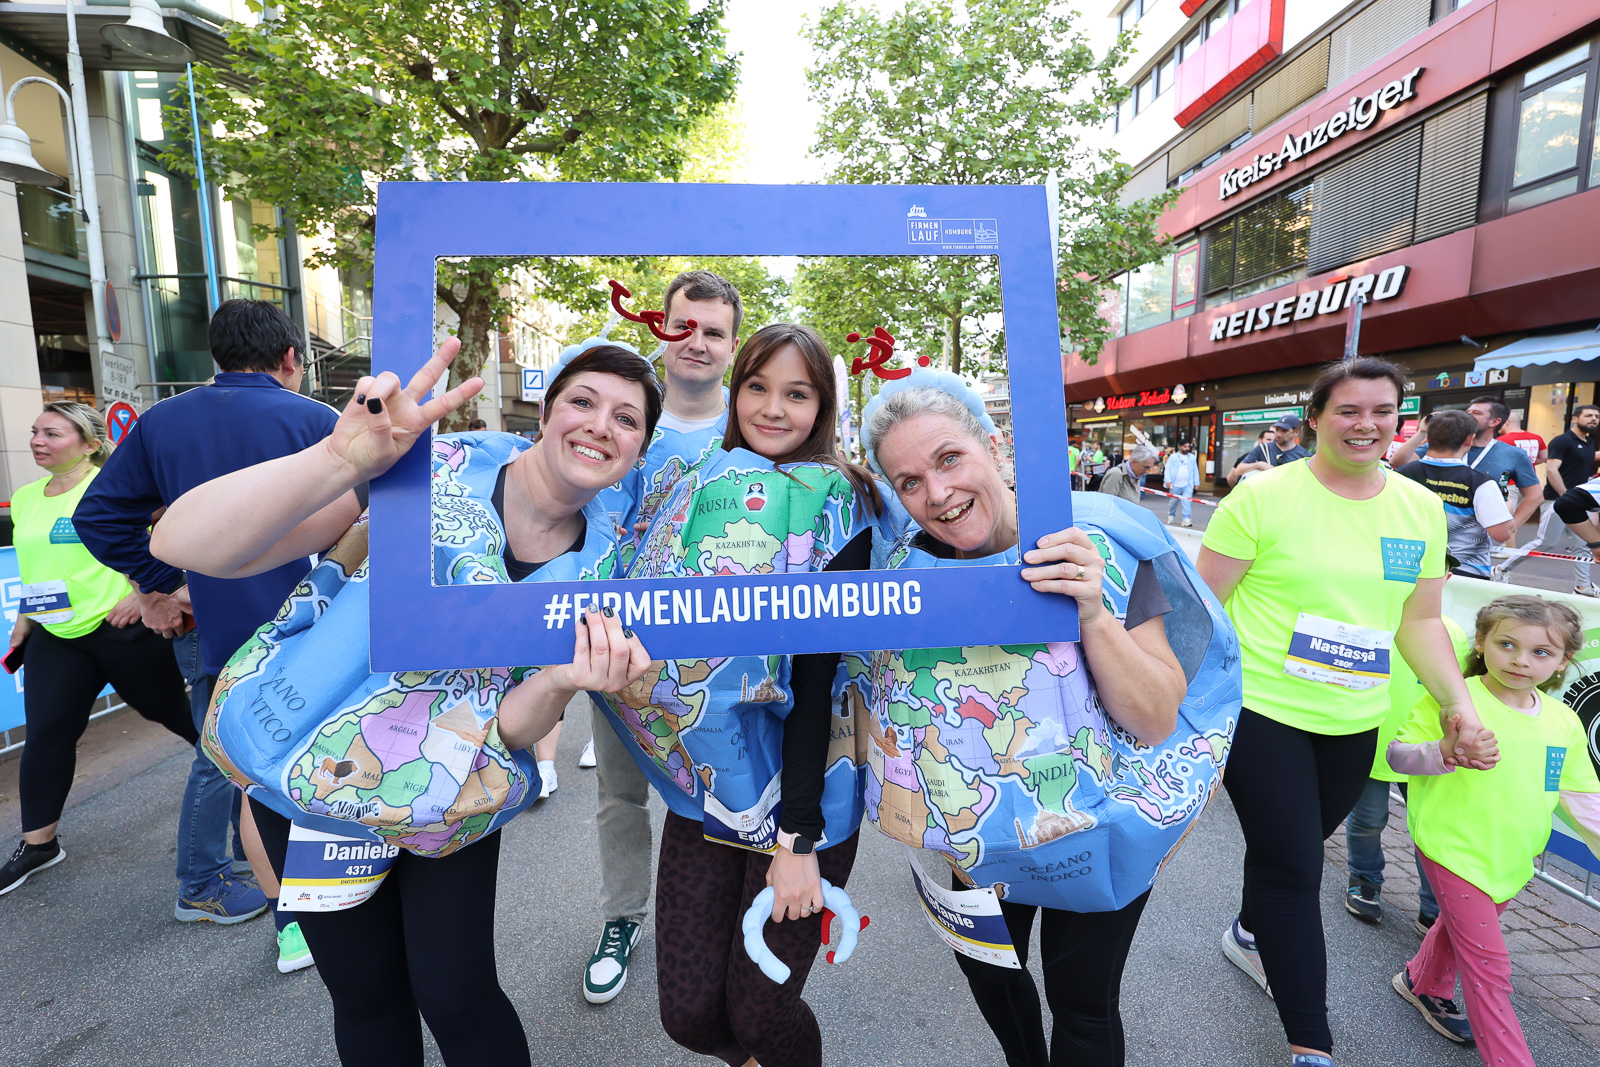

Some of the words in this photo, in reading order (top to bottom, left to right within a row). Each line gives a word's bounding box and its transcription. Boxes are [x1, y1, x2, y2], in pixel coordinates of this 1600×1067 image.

[1218, 67, 1424, 201] Kreis-Anzeiger
[910, 221, 939, 230] FIRMEN
[911, 230, 939, 241] LAUF
[1208, 265, 1407, 342] REISEBÜRO
[105, 360, 133, 375] werktags
[1137, 388, 1171, 406] Kebab
[1264, 393, 1298, 404] Linienflug
[697, 497, 739, 516] RUSIA
[715, 539, 767, 550] KAZAKHSTAN
[1386, 543, 1422, 551] KIEFER
[954, 662, 1012, 677] KAZAKHSTAN
[388, 724, 418, 736] ARGELIA
[945, 737, 964, 746] IRAN
[1031, 760, 1076, 787] INDIA
[403, 781, 429, 794] NIGER
[926, 777, 945, 787] SAUDI
[737, 814, 776, 843] Emily
[323, 842, 400, 861] Daniela
[345, 864, 373, 876] 4371
